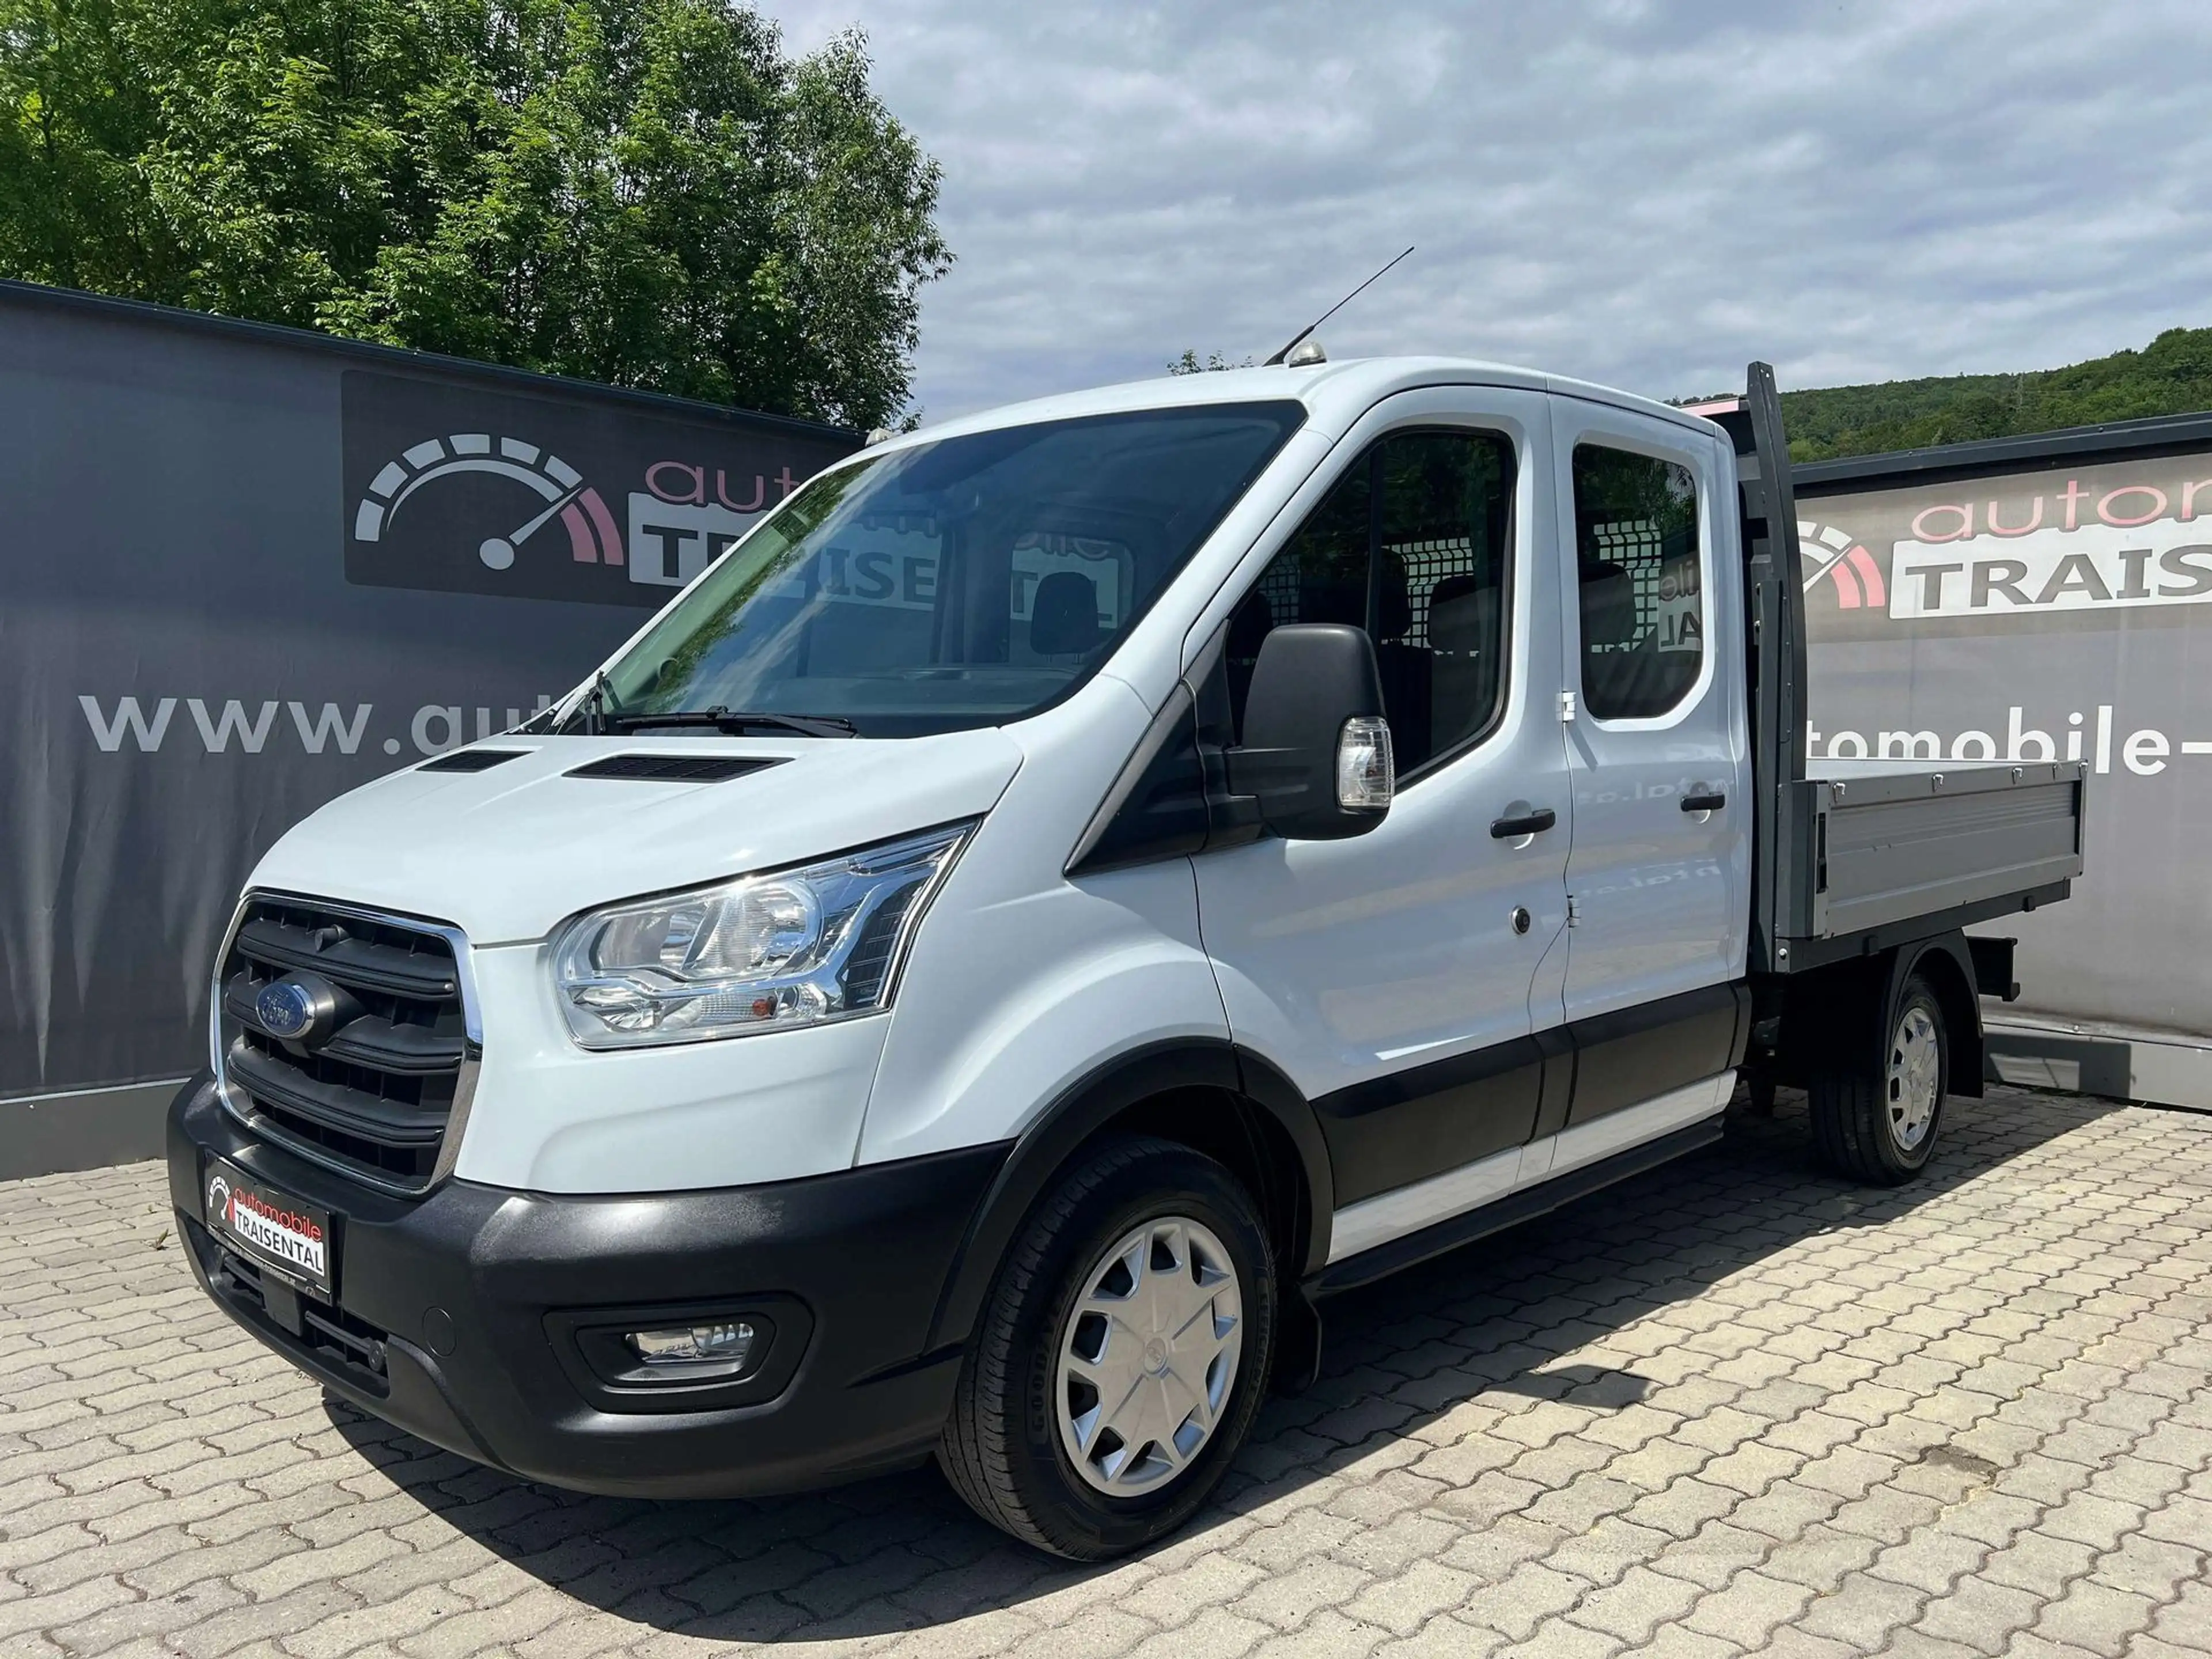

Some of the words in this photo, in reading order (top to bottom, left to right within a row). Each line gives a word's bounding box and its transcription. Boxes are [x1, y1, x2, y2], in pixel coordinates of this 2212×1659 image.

[1905, 544, 2212, 611] TRAIS
[234, 1188, 322, 1243] automobile
[236, 1210, 323, 1272] TRAISENTAL
